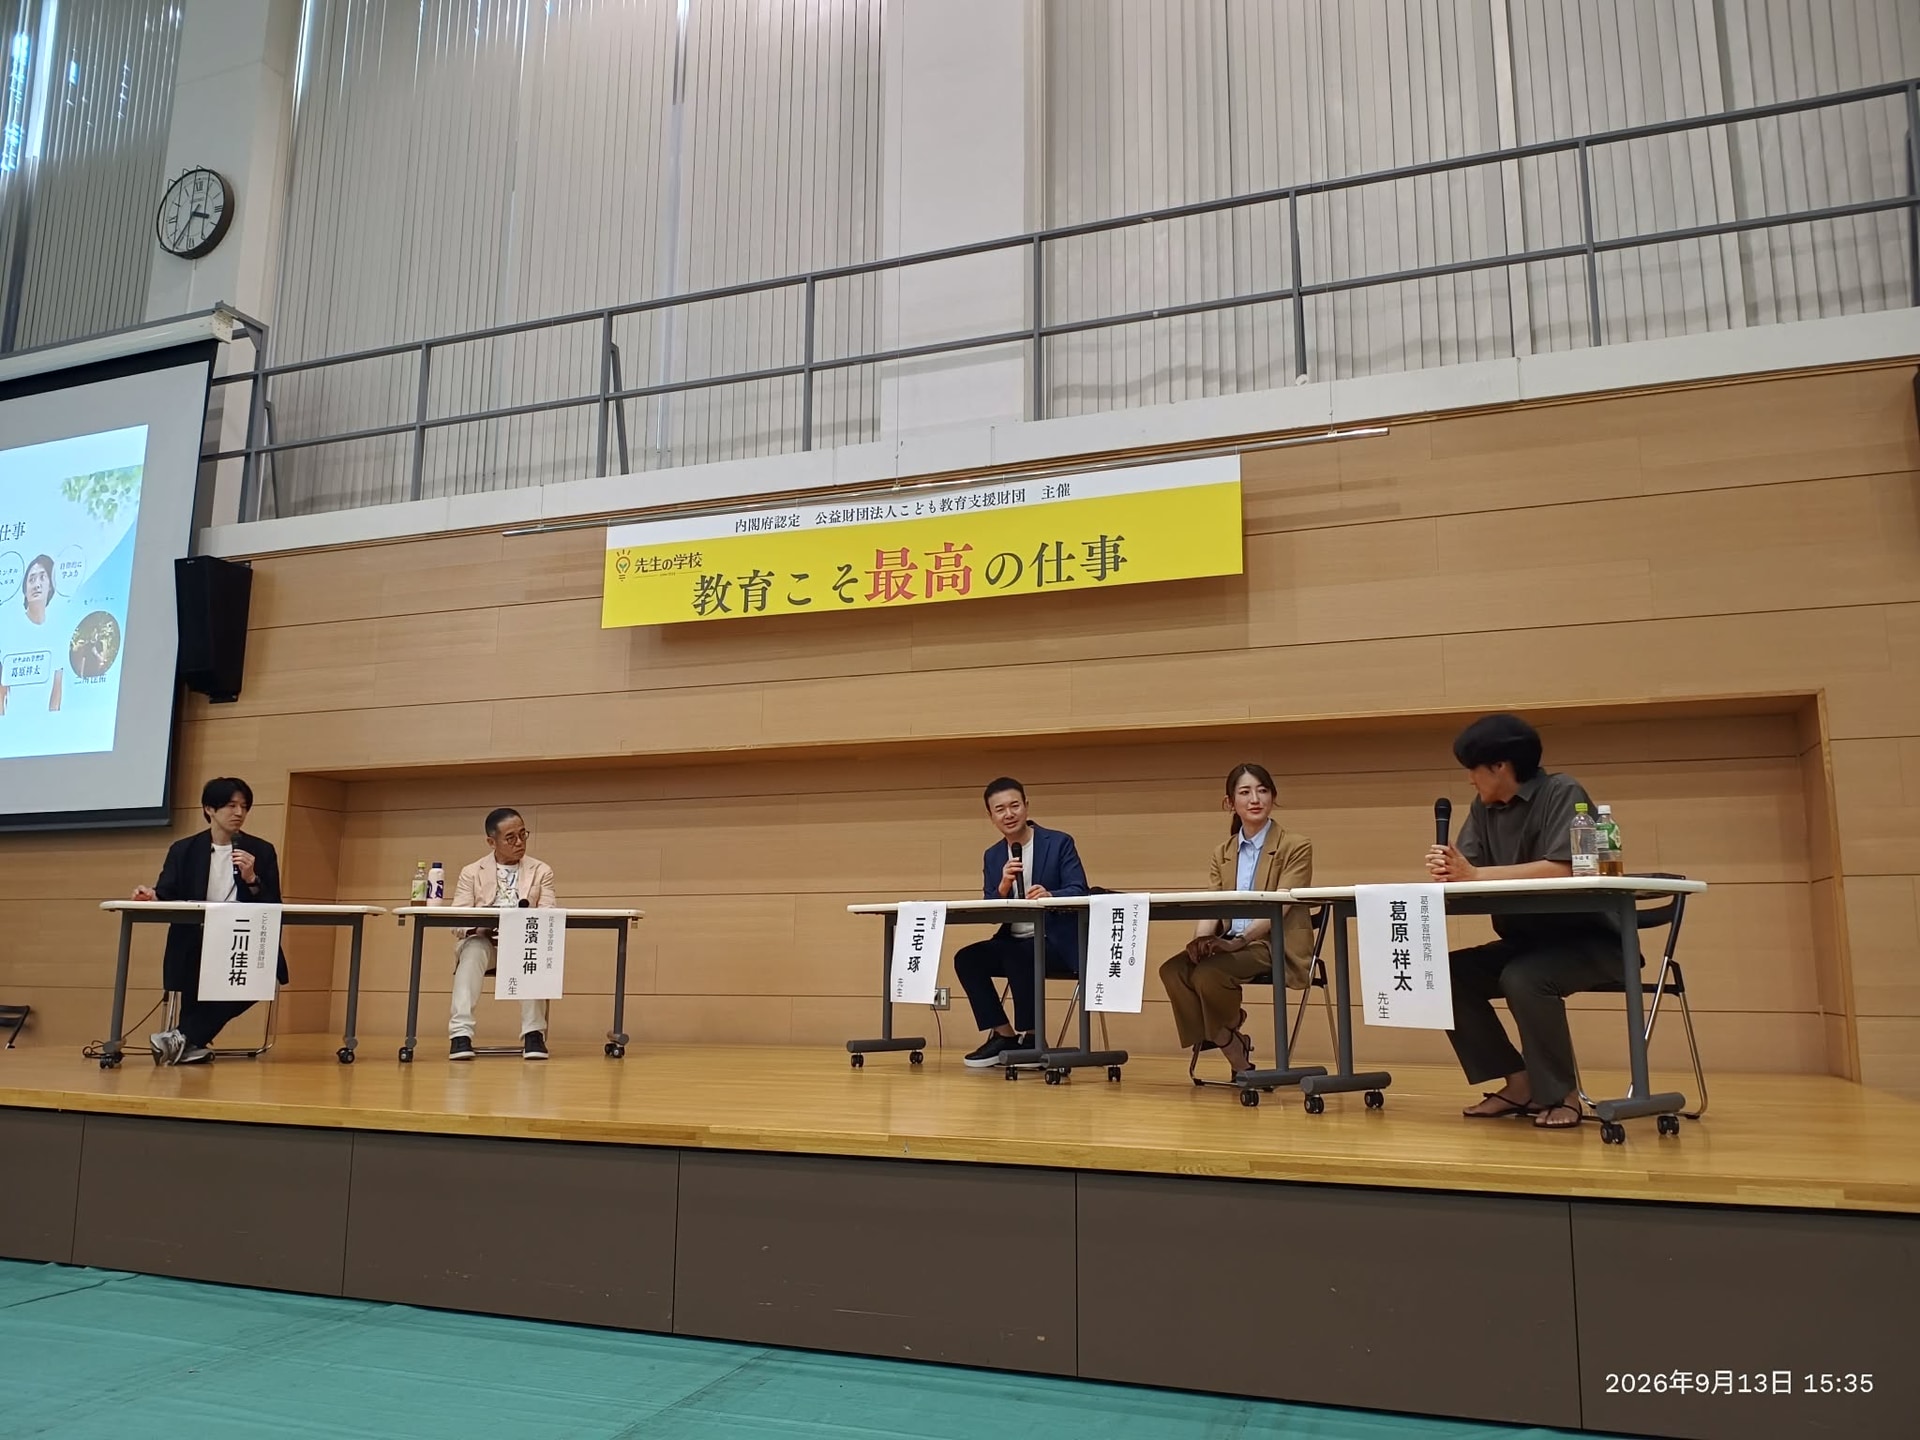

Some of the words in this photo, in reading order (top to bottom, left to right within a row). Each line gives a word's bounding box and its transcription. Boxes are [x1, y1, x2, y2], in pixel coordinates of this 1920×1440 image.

[735, 514, 800, 533] 内閣府認定
[815, 488, 1026, 525] 公益財団法人こども教育支援財団
[1041, 483, 1071, 500] 主催
[634, 552, 703, 574] 先生の学校
[691, 535, 1128, 616] 教育こそ最高の仕事
[228, 919, 251, 986] 二川佳祐
[1108, 908, 1125, 978] 西村佑美
[508, 977, 518, 995] 先生
[1094, 982, 1104, 1006] 先生
[1378, 992, 1390, 1019] 先生
